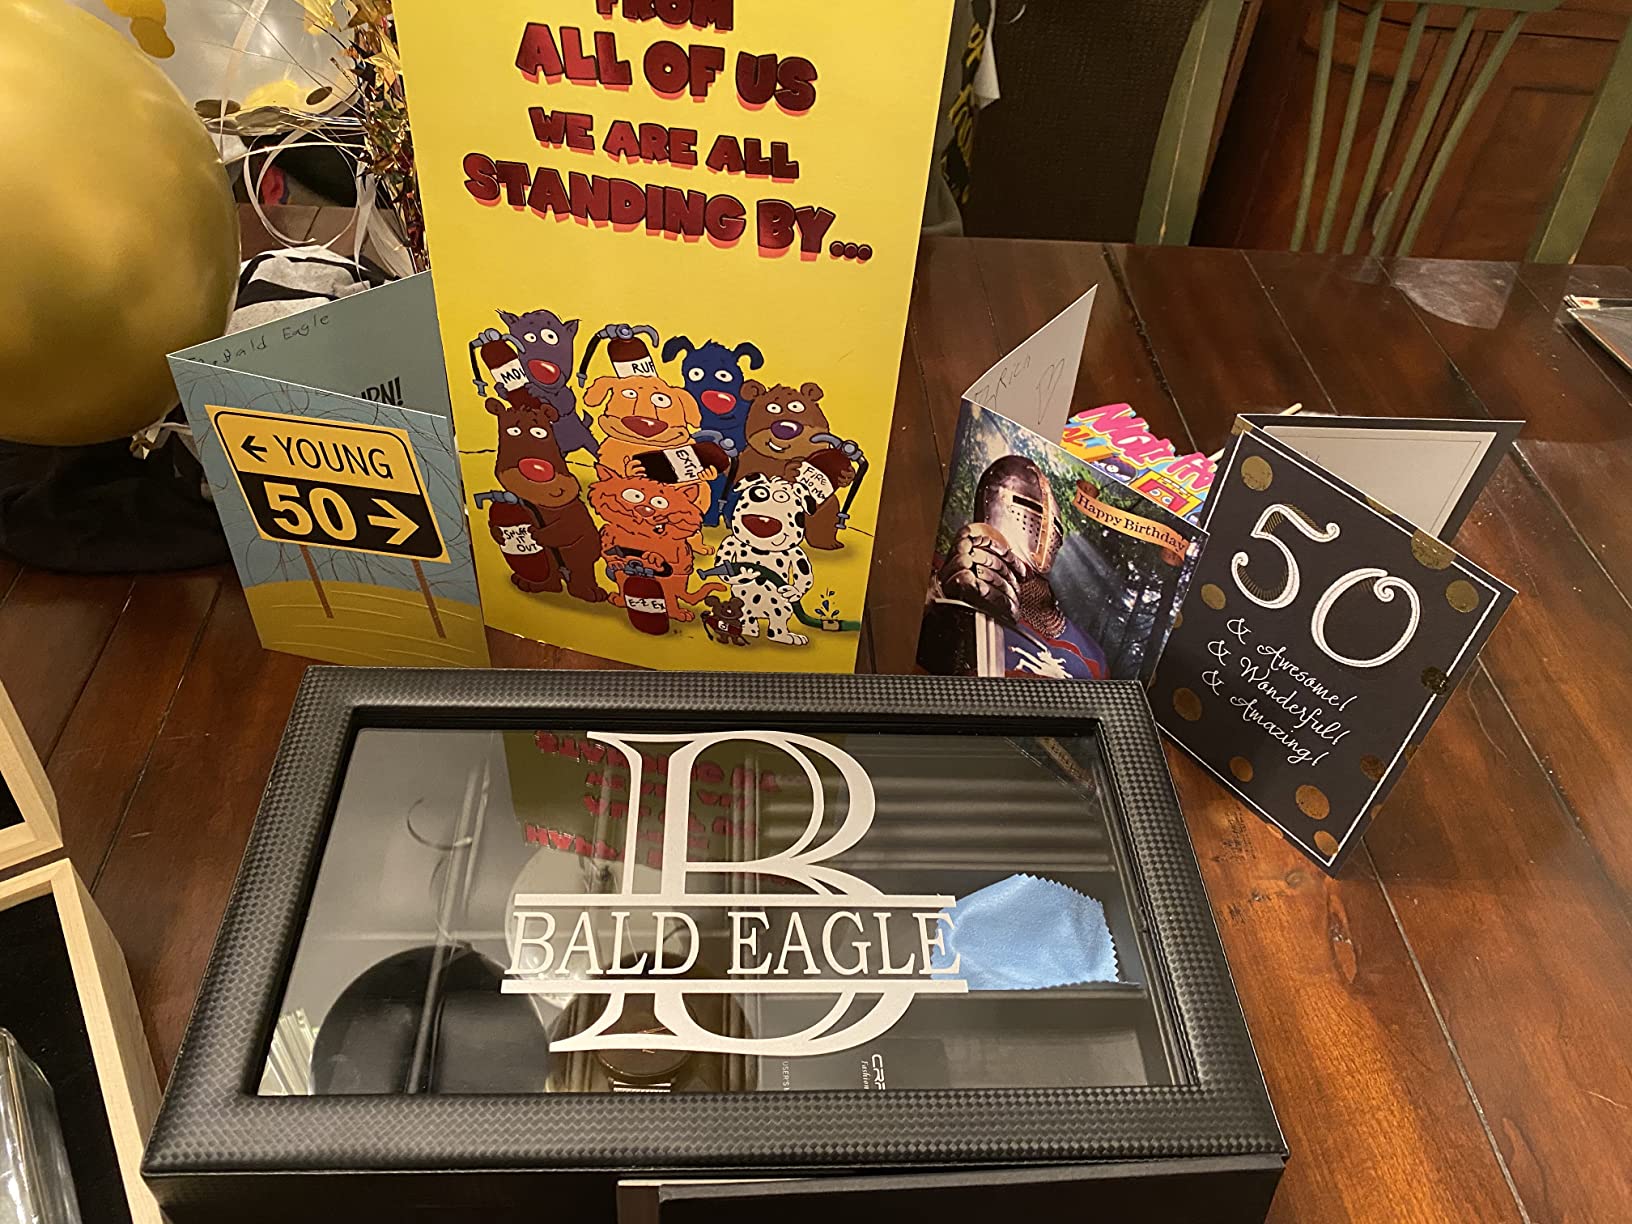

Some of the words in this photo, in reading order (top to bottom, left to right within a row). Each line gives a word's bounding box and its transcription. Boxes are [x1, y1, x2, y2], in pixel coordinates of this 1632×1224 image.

[515, 22, 633, 91] ALL
[643, 40, 726, 102] OF
[735, 51, 819, 116] US
[528, 107, 596, 151] WE
[602, 120, 698, 170] ARE
[705, 135, 800, 183] ALL
[462, 152, 747, 248] STANDING
[756, 199, 874, 262] BY...
[282, 314, 330, 341] Eagle
[272, 434, 394, 480] YOUNG
[263, 481, 358, 541] 50
[516, 543, 538, 552] OUT
[1077, 494, 1122, 526] Happy
[1123, 517, 1187, 553] Birthday
[1231, 503, 1421, 668] 50
[1207, 639, 1232, 667] &
[1239, 656, 1351, 746] Wonderful!
[1226, 617, 1252, 645] &
[1256, 644, 1358, 712] Awesome!
[1201, 669, 1225, 696] &
[1229, 696, 1330, 767] Amazing!
[504, 911, 700, 976] BALD
[727, 911, 961, 976] EAGLE
